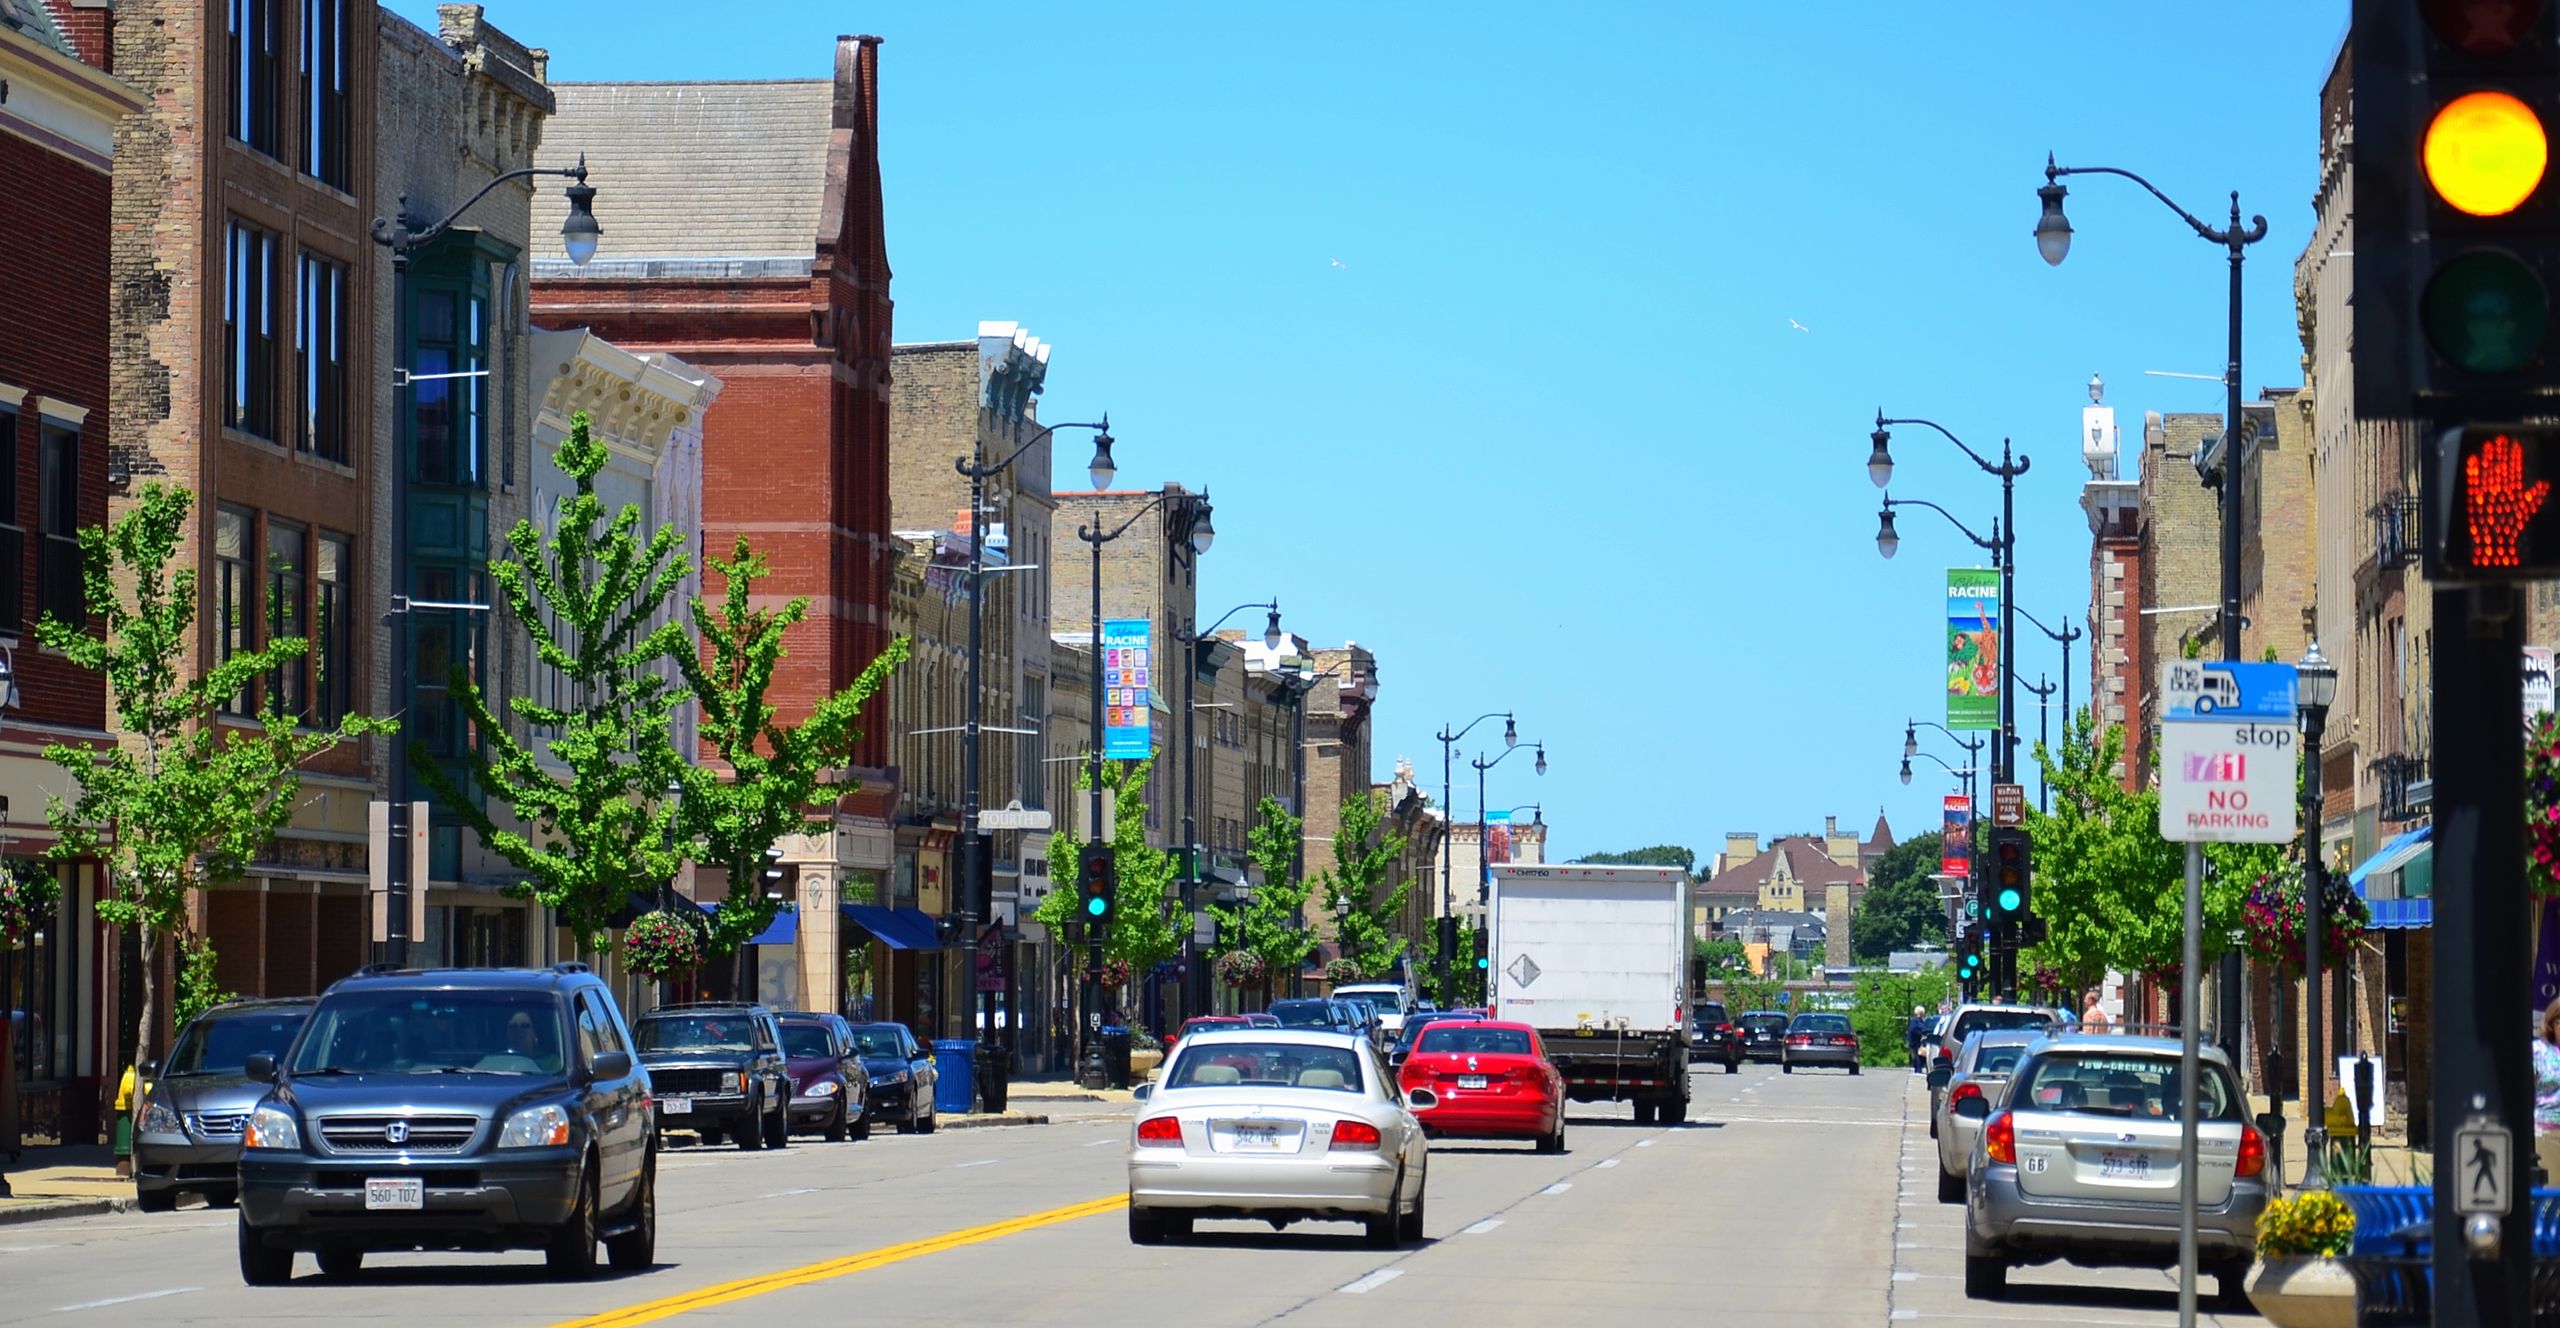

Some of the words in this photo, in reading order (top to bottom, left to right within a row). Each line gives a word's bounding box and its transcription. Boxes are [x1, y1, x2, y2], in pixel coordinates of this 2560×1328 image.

[1948, 586, 1998, 598] RACINE
[1106, 635, 1148, 646] RACINE
[2173, 666, 2198, 681] the
[2170, 676, 2200, 695] bus
[2236, 723, 2291, 750] stop
[2208, 790, 2248, 810] NO
[984, 813, 1033, 826] FOURTH
[2187, 813, 2269, 829] PARKING
[2028, 1158, 2045, 1173] GB
